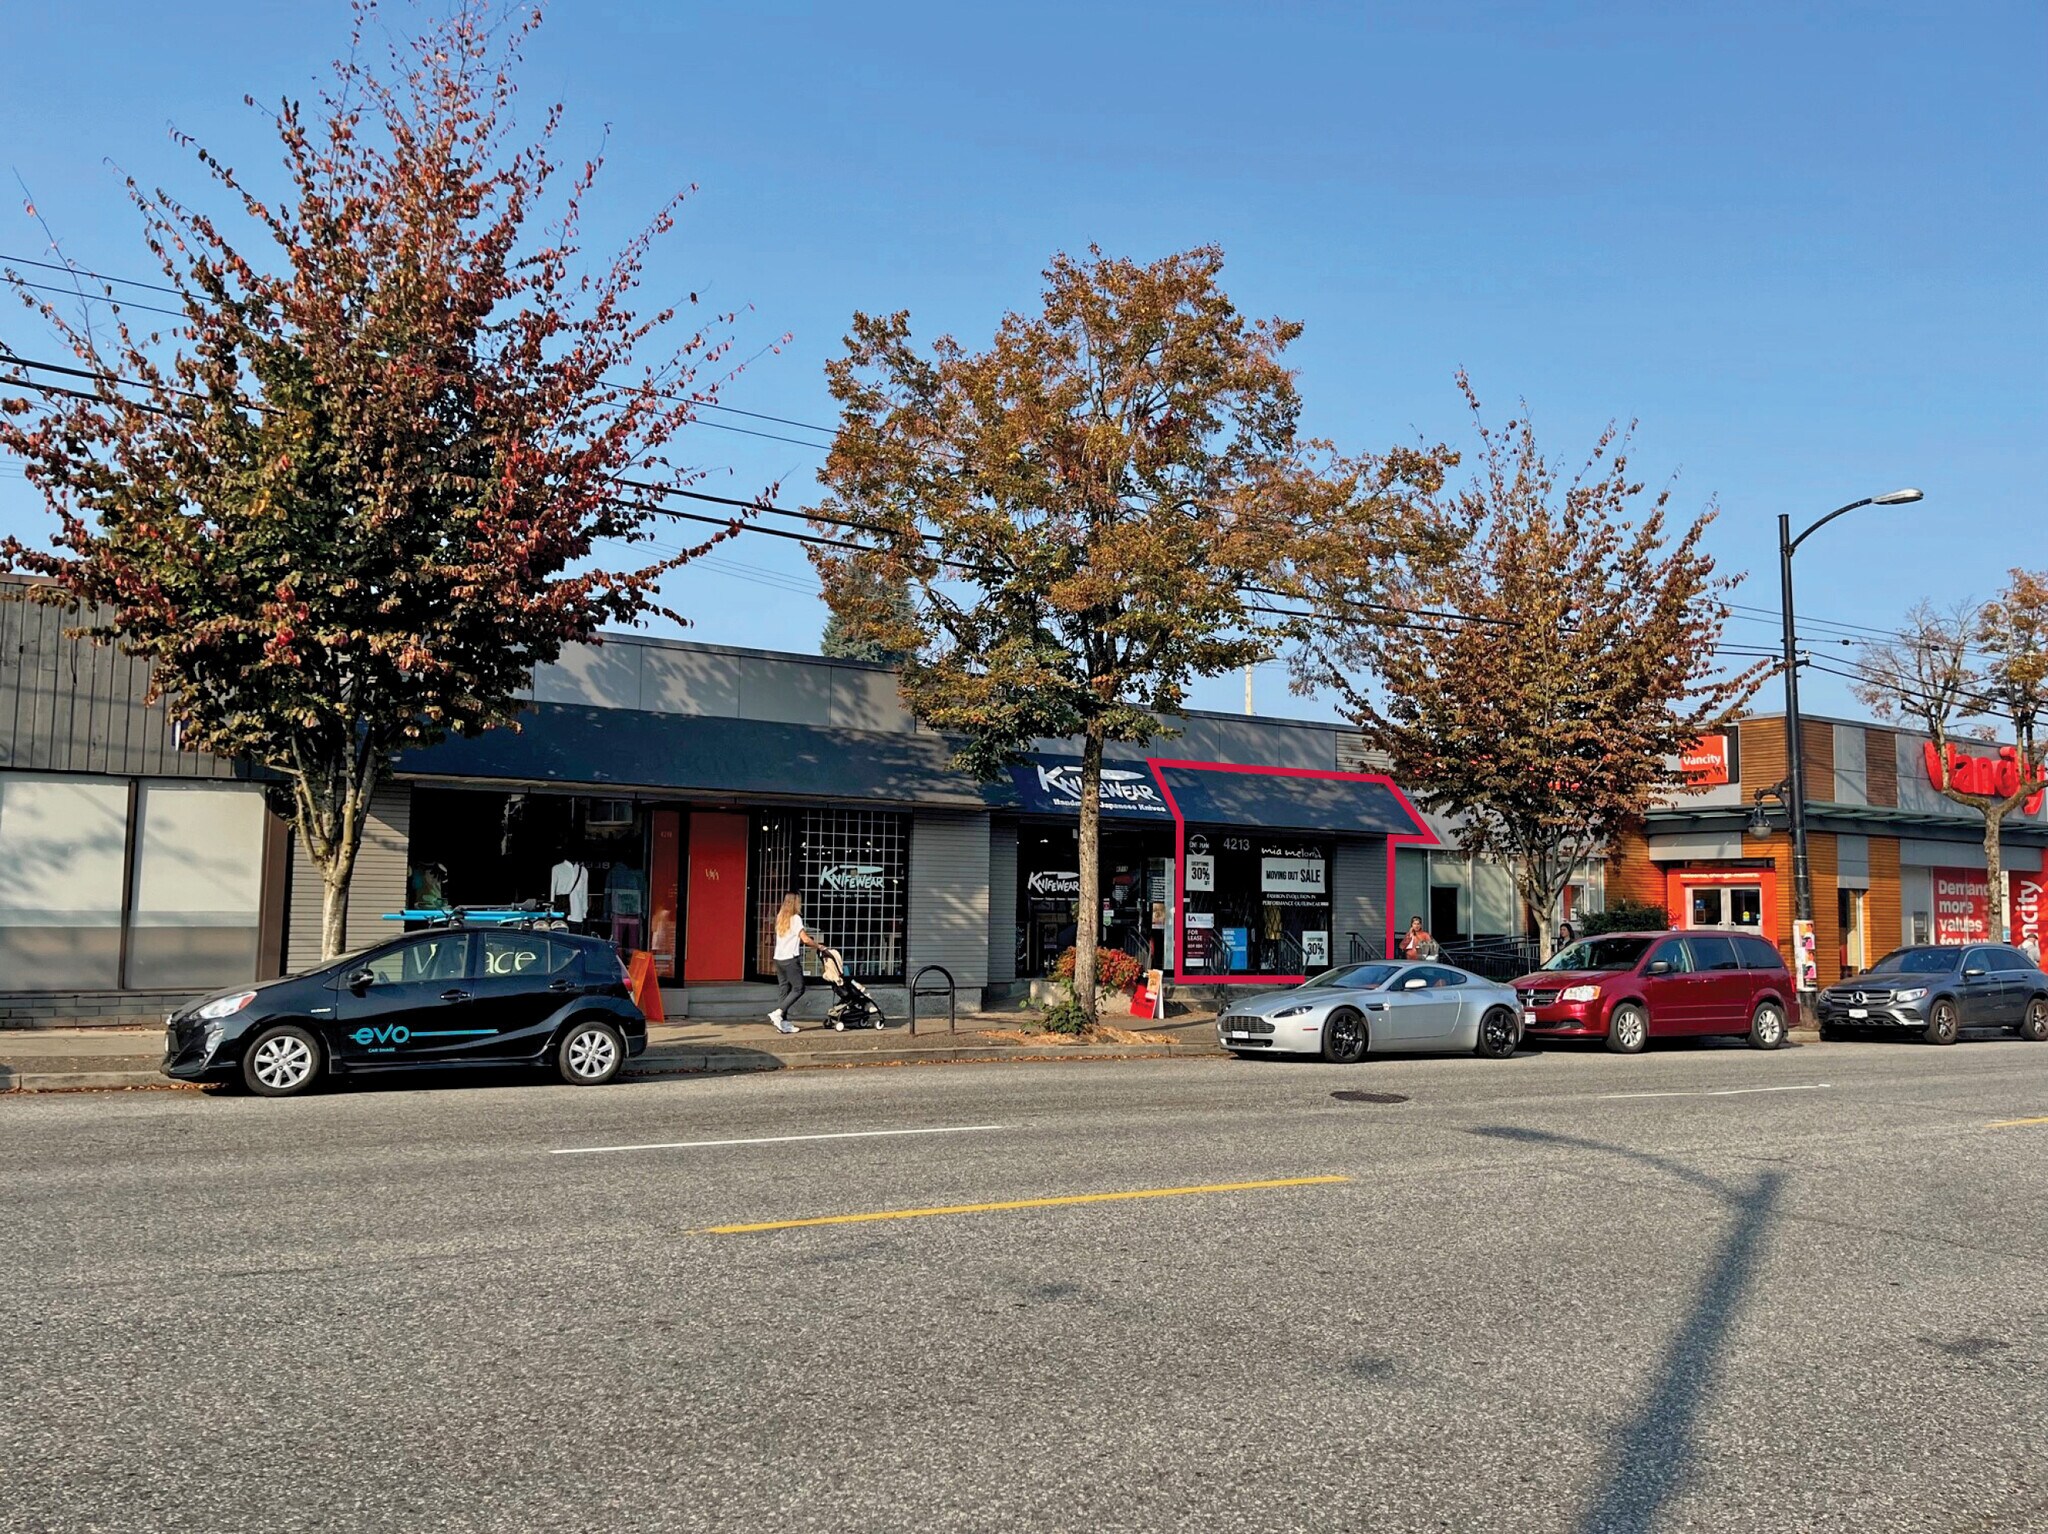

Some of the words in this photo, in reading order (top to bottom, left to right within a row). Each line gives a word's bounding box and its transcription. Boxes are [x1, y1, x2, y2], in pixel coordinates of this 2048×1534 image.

[1683, 753, 1721, 765] Vancity
[1138, 803, 1166, 812] Knives
[1223, 838, 1250, 851] 4213
[1191, 867, 1210, 880] 30%
[1266, 870, 1286, 880] MOVING
[1288, 871, 1298, 880] OUT
[1300, 869, 1321, 883] SALE
[1938, 901, 1974, 914] more
[1938, 915, 1983, 932] values
[1307, 942, 1324, 955] 30%
[355, 1023, 410, 1045] evo
